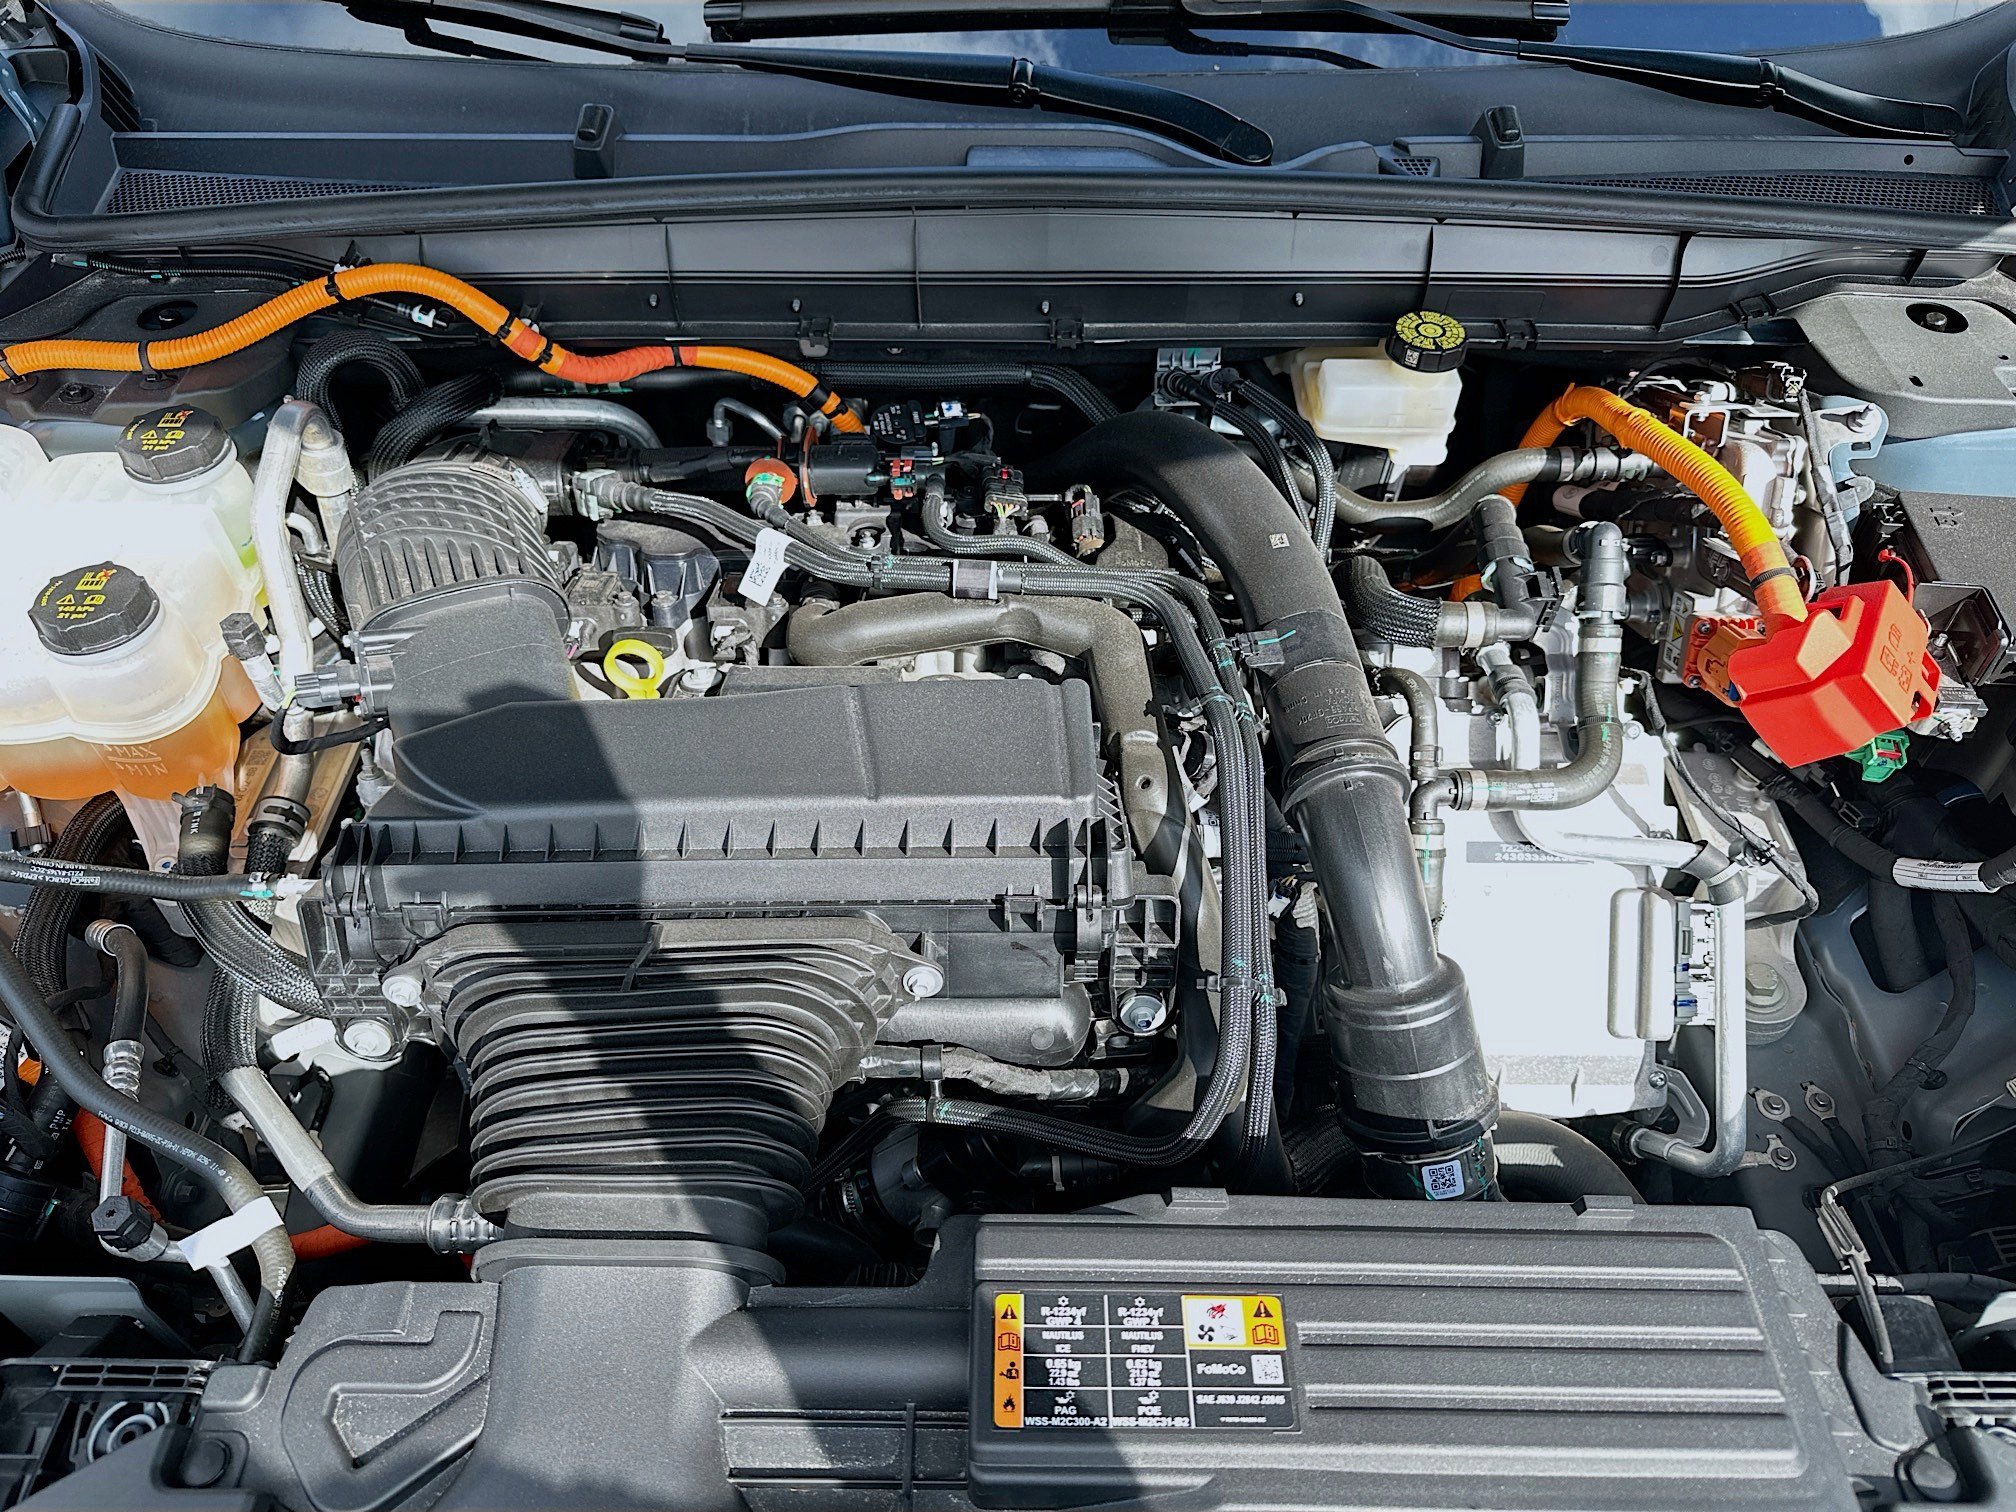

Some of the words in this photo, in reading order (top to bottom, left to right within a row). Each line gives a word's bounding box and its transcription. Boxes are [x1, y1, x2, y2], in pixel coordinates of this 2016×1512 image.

[113, 744, 157, 758] MAX
[1042, 1330, 1085, 1340] NAUTILUS
[1121, 1330, 1164, 1340] NAUTILUS
[1055, 1344, 1071, 1353] ICE
[1068, 1358, 1081, 1371] kg
[1148, 1358, 1162, 1371] kg
[1196, 1363, 1247, 1375] FoMoCo
[1048, 1377, 1066, 1386] 1.43
[1054, 1405, 1077, 1415] PAG
[1137, 1405, 1162, 1416] POE
[1024, 1416, 1108, 1426] WSS-M2C300-A2
